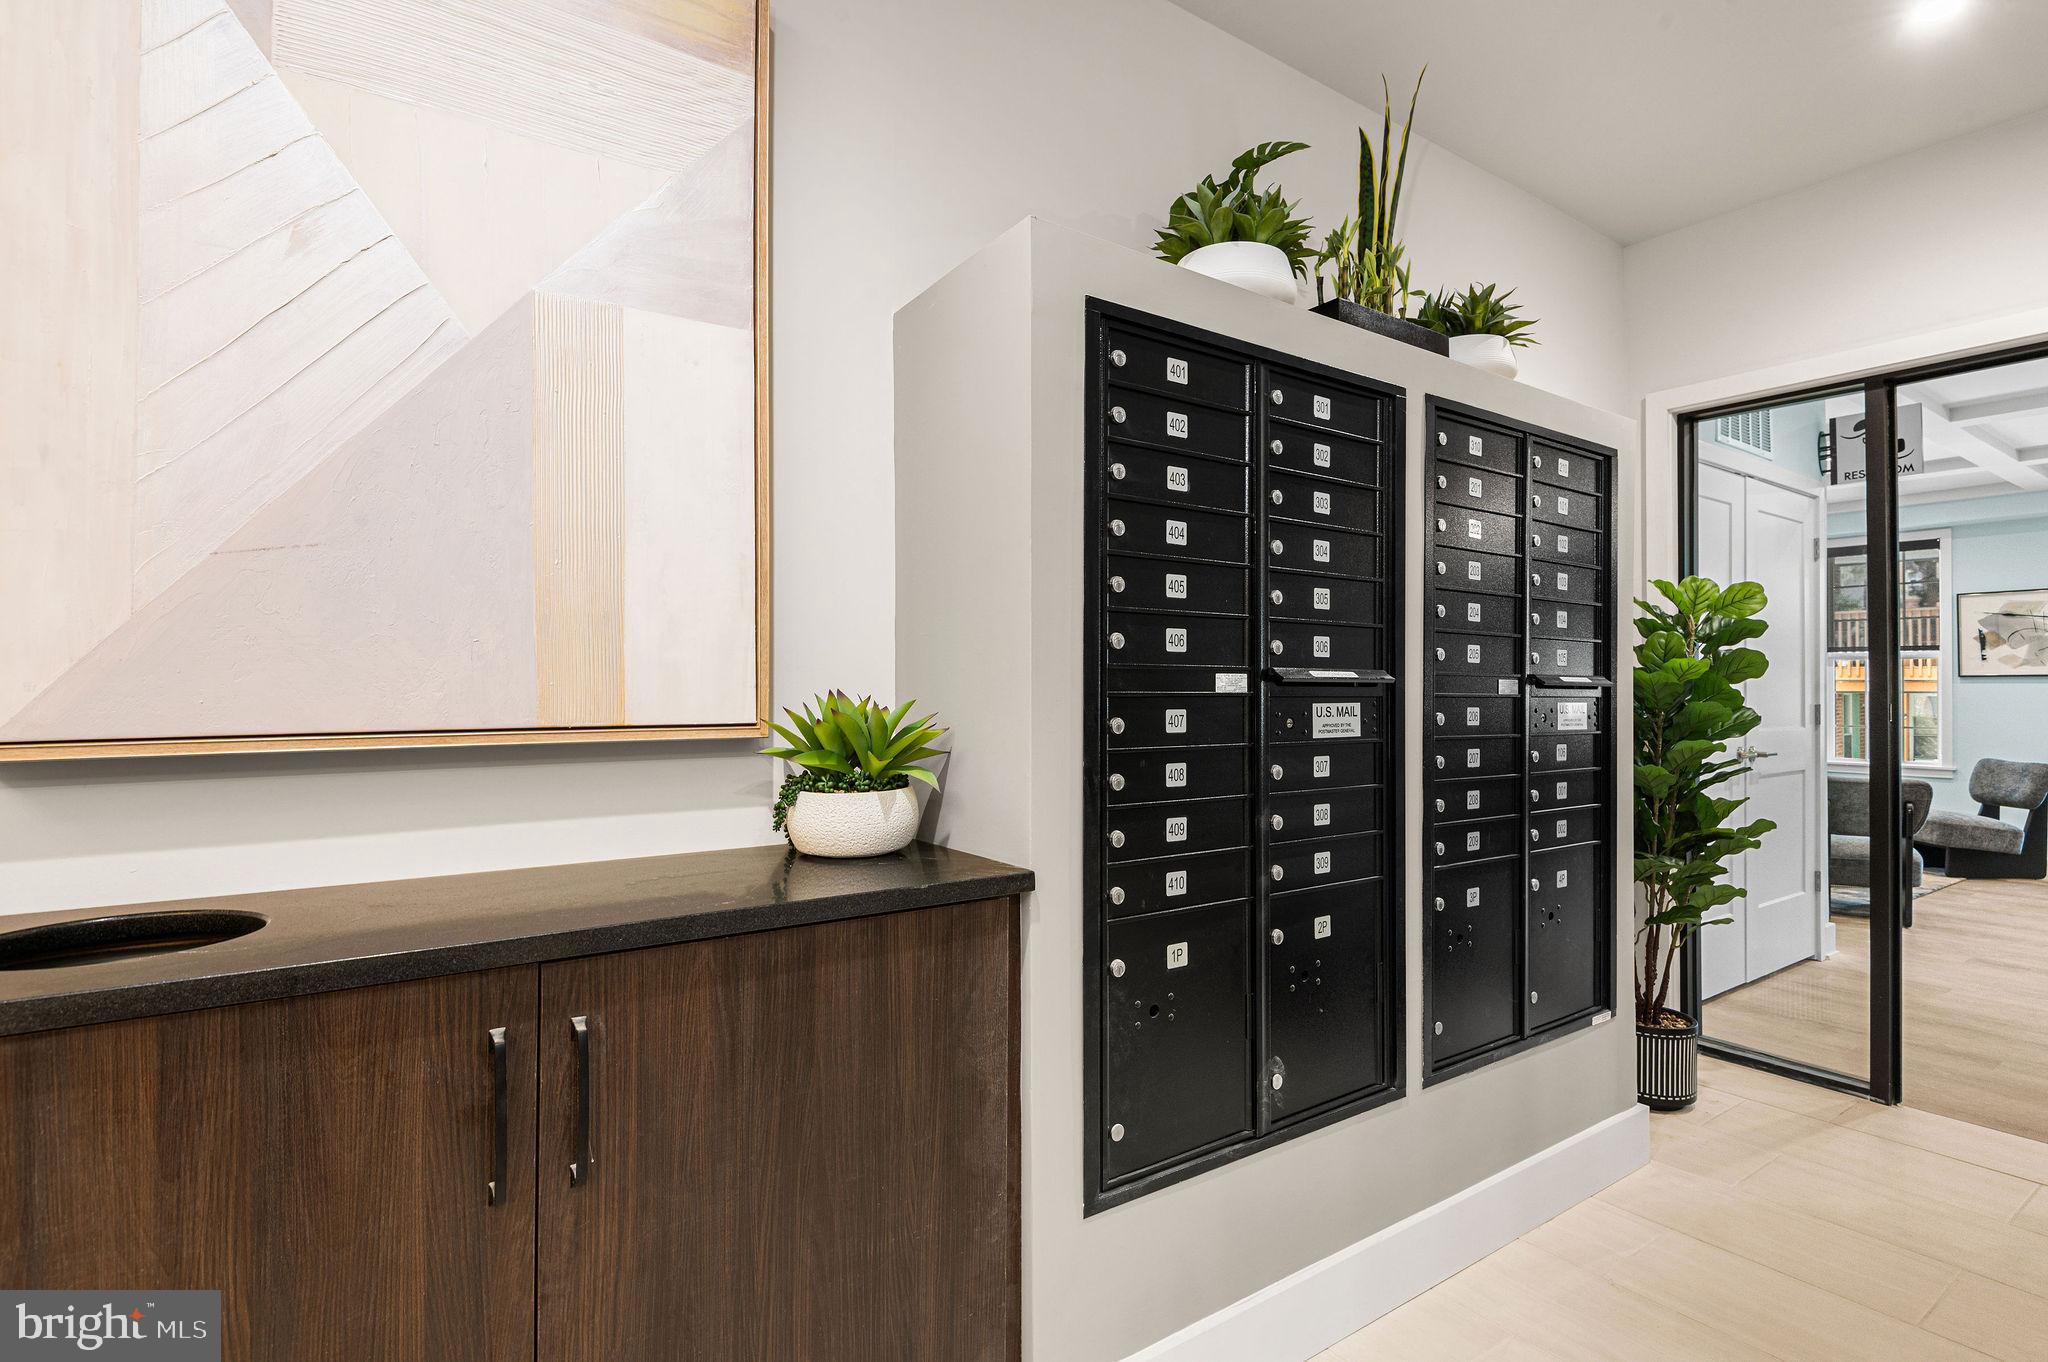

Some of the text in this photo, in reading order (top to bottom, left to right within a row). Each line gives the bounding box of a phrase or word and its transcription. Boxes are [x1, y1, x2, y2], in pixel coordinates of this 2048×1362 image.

[1169, 363, 1186, 379] 401
[1316, 400, 1329, 415] 301
[1169, 417, 1186, 434] 402
[1469, 440, 1481, 454] 310
[1315, 448, 1329, 463] 302
[1169, 471, 1186, 487] 403
[1844, 463, 1915, 481] RESM
[1470, 481, 1481, 494] 201
[1315, 496, 1329, 510] 303
[1168, 525, 1185, 540] 404
[1315, 544, 1328, 558] 304
[1470, 564, 1480, 577] 203
[1168, 579, 1185, 594] 405
[1315, 592, 1329, 606] 305
[1469, 606, 1479, 618] 204
[1168, 633, 1185, 648] 406
[1315, 640, 1329, 653] 306
[1468, 648, 1480, 660] 205
[1316, 705, 1358, 718] U.S. MAIL
[1468, 710, 1479, 722] 206
[1167, 714, 1185, 728] 407
[1468, 752, 1479, 764] 207
[1315, 760, 1328, 773] 307
[1168, 767, 1185, 782] 408
[1468, 794, 1479, 806] 208
[1315, 808, 1329, 822] 308
[1168, 822, 1185, 837] 409
[1468, 835, 1479, 847] 209
[1316, 856, 1329, 870] 309
[1168, 875, 1185, 891] 410
[1469, 891, 1478, 903] 3P
[1317, 920, 1328, 934] 2P
[1171, 948, 1184, 963] 1P
